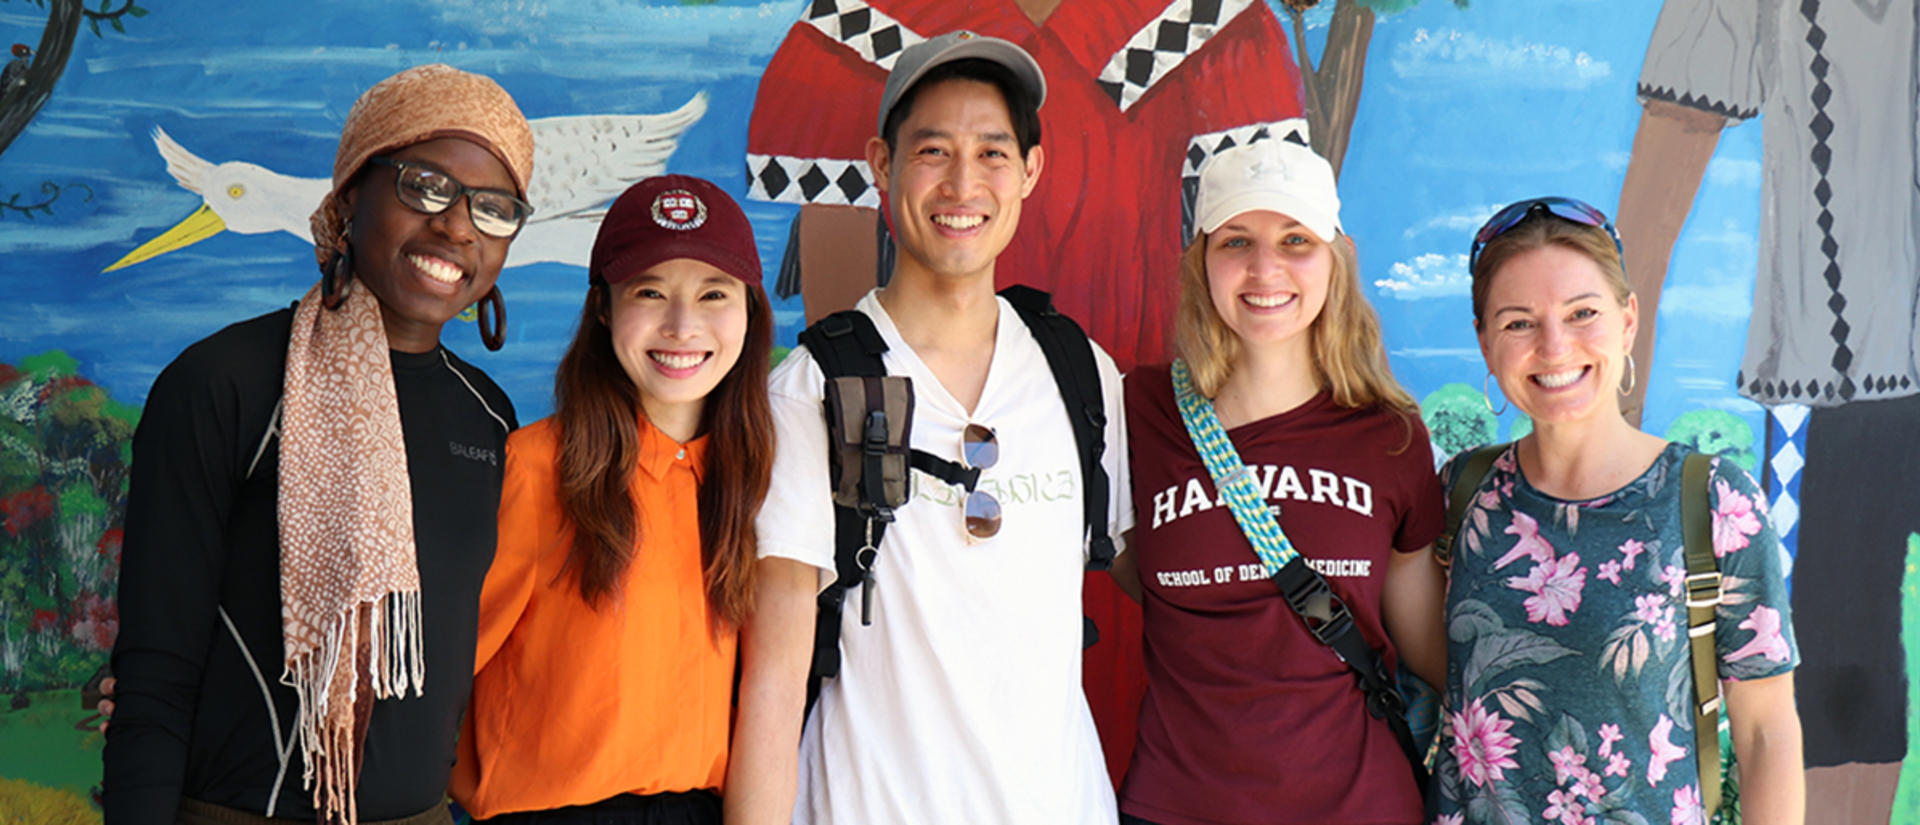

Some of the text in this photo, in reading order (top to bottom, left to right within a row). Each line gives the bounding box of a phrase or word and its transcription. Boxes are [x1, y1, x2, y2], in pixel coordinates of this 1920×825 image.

[1152, 464, 1373, 529] HAVARD
[1157, 567, 1211, 586] SCHOOL
[1214, 566, 1234, 583] OF
[1238, 563, 1271, 581] DEN
